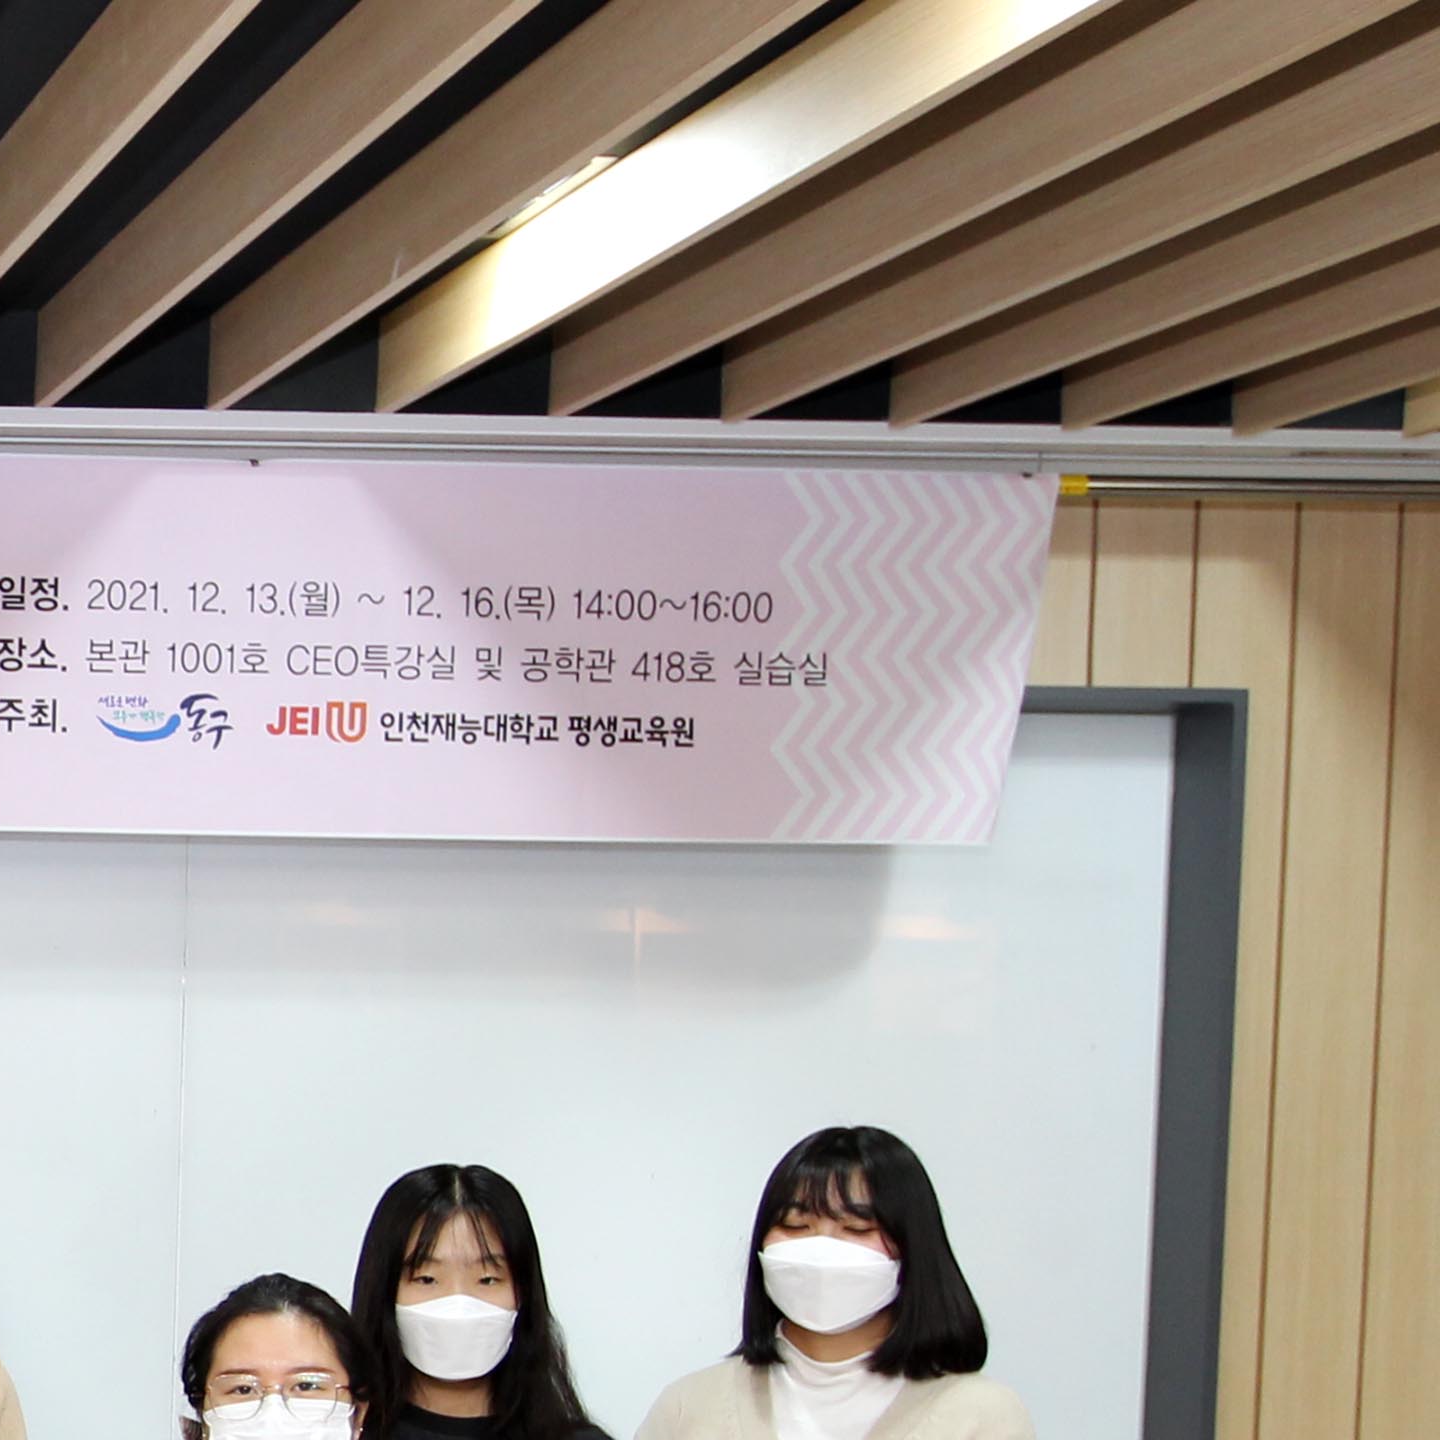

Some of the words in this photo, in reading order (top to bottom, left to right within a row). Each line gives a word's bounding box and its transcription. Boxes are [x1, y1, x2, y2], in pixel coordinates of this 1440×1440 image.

[87, 579, 168, 613] 2021.
[188, 582, 226, 614] 12.
[247, 581, 339, 617] 13.(월)
[404, 585, 441, 618] 12.
[462, 586, 555, 621] 16.(목)
[573, 589, 773, 623] 14:00~16:00
[86, 639, 150, 674] 본관
[167, 642, 269, 673] 1001호
[287, 645, 455, 680] CEO특강실
[476, 646, 502, 681] 및
[521, 647, 616, 683] 공학관
[631, 651, 716, 683] 418호
[735, 652, 826, 686] 실습실
[178, 693, 233, 749] 동구
[380, 712, 560, 746] 인천재능대학교
[568, 715, 694, 748] 평생교육원
